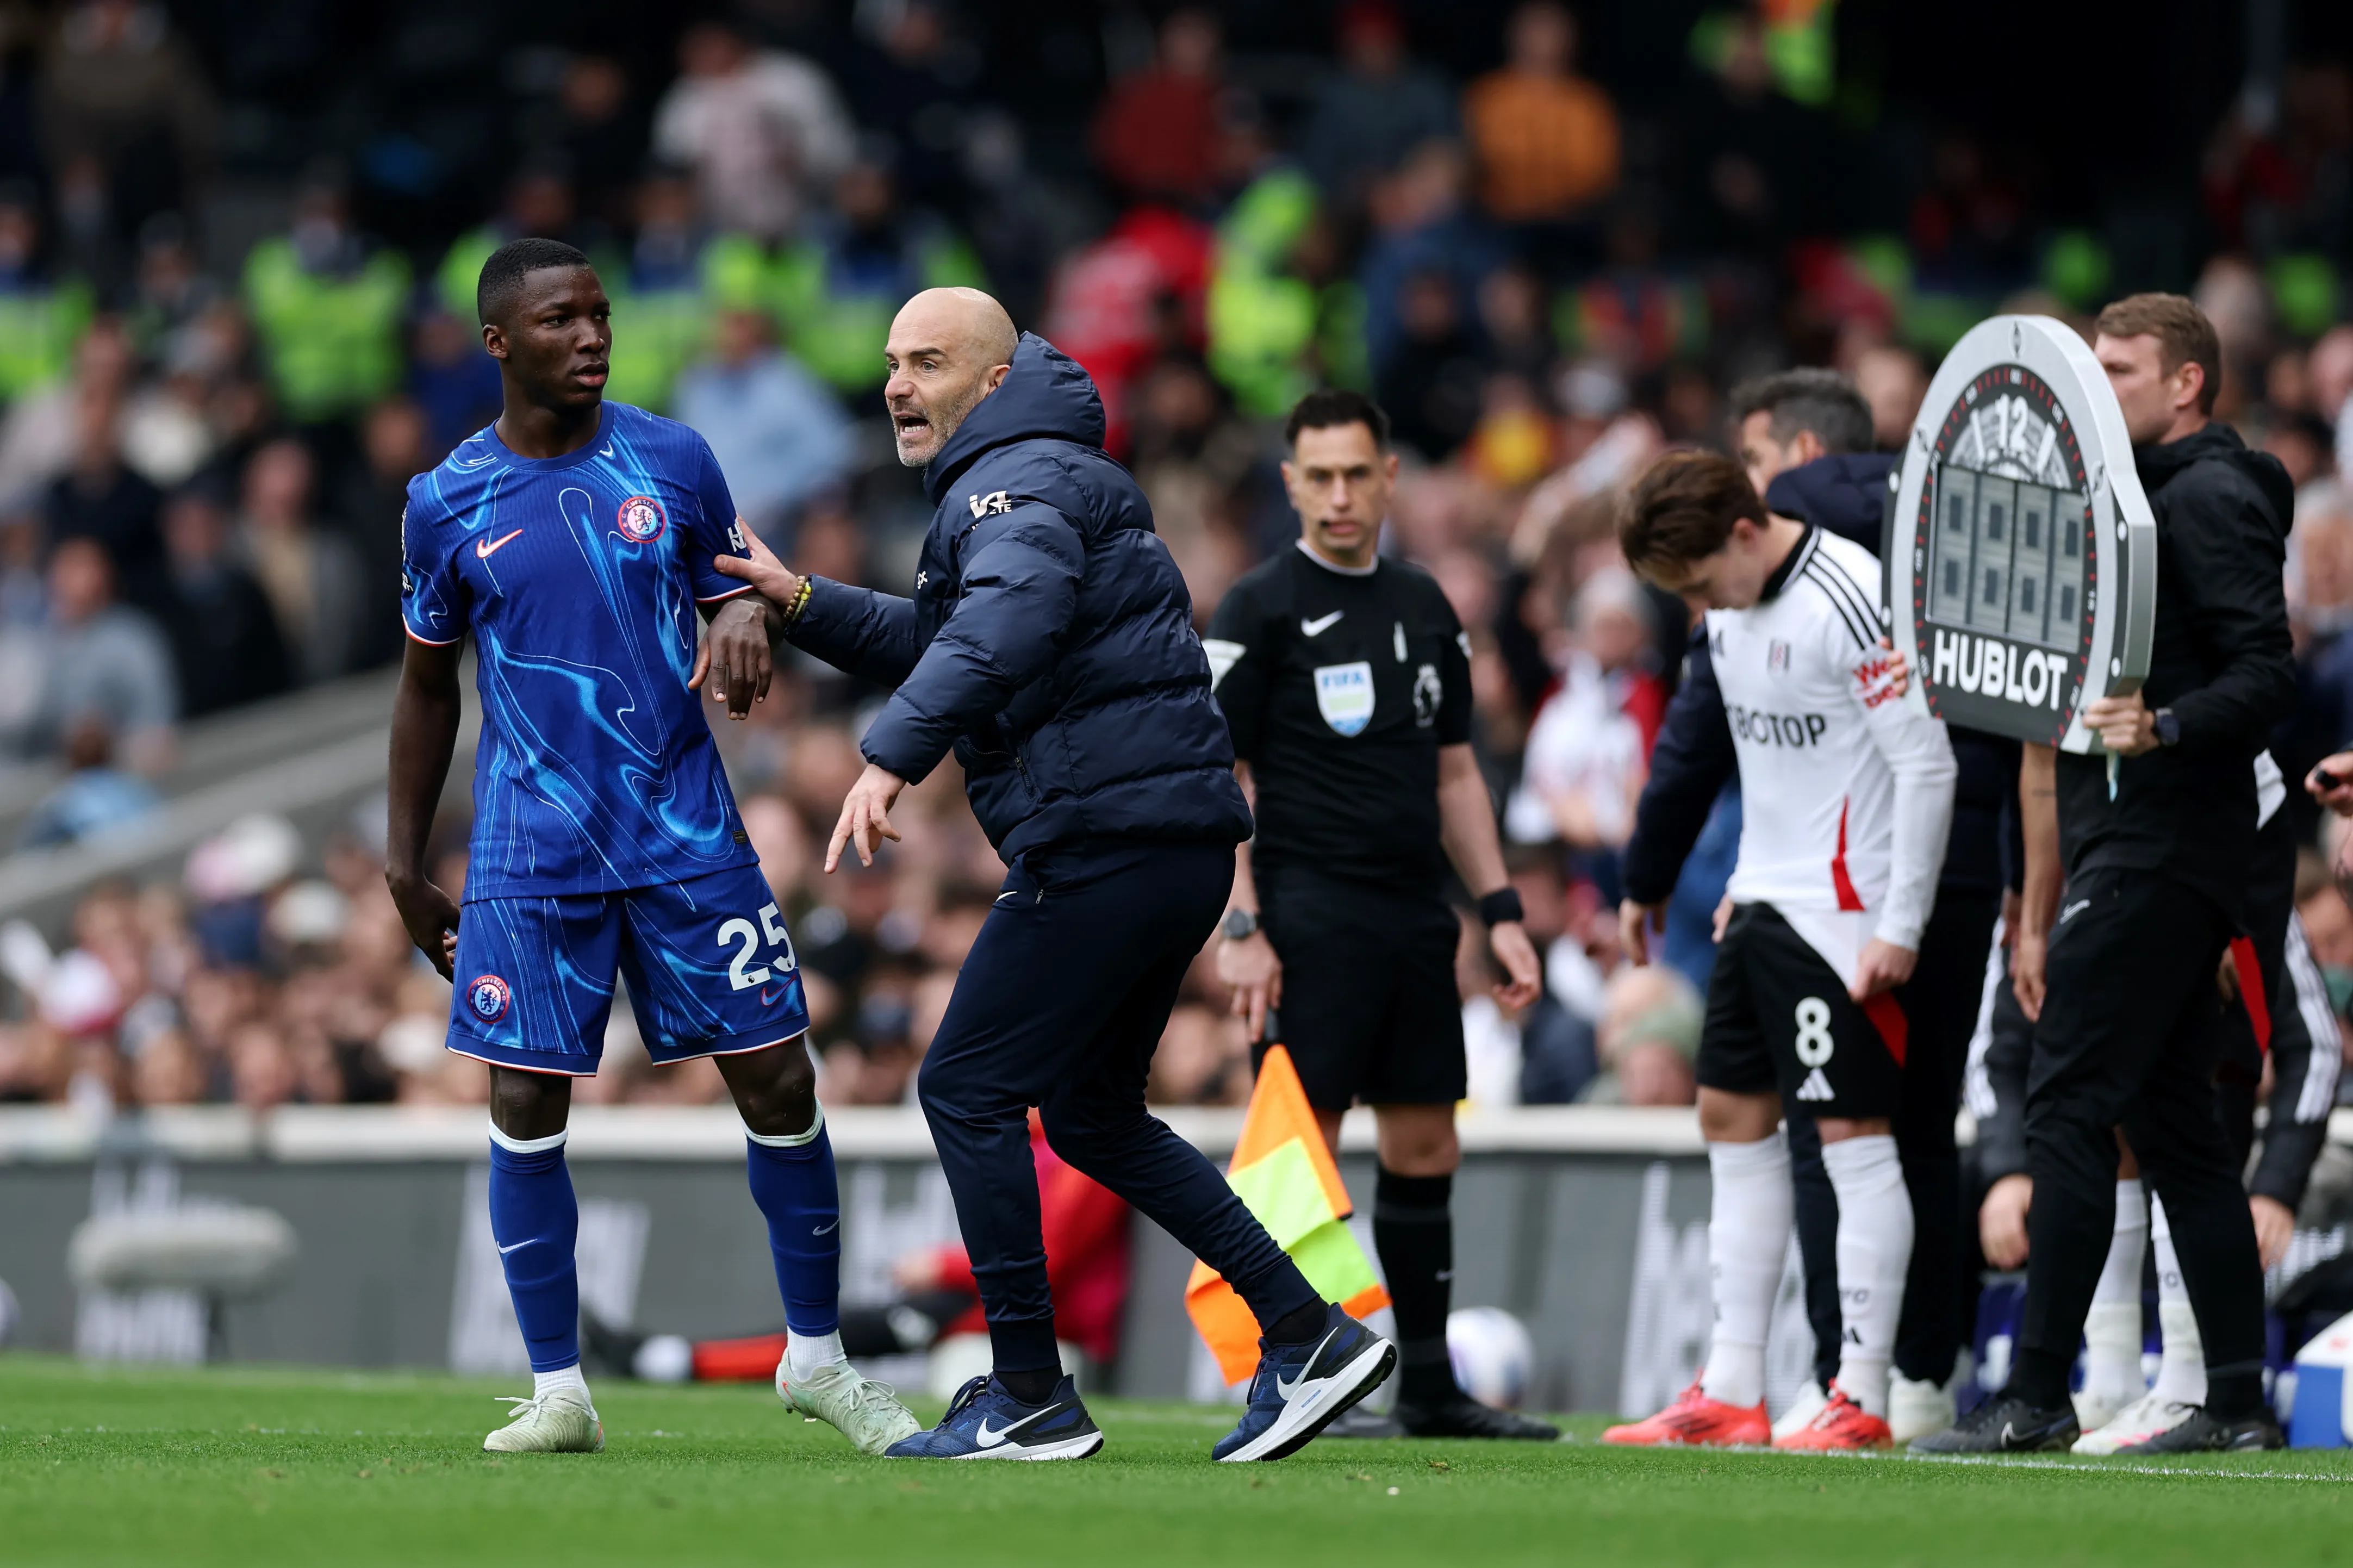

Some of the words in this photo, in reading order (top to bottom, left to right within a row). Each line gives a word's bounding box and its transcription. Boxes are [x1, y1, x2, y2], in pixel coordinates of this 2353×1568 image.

[1995, 391, 2028, 452] 12
[626, 499, 655, 509] CHELSEA
[1933, 629, 2068, 711] HUBLOT
[718, 901, 795, 991] 25
[477, 978, 503, 991] CHELSEA
[1795, 996, 1834, 1068] 8
